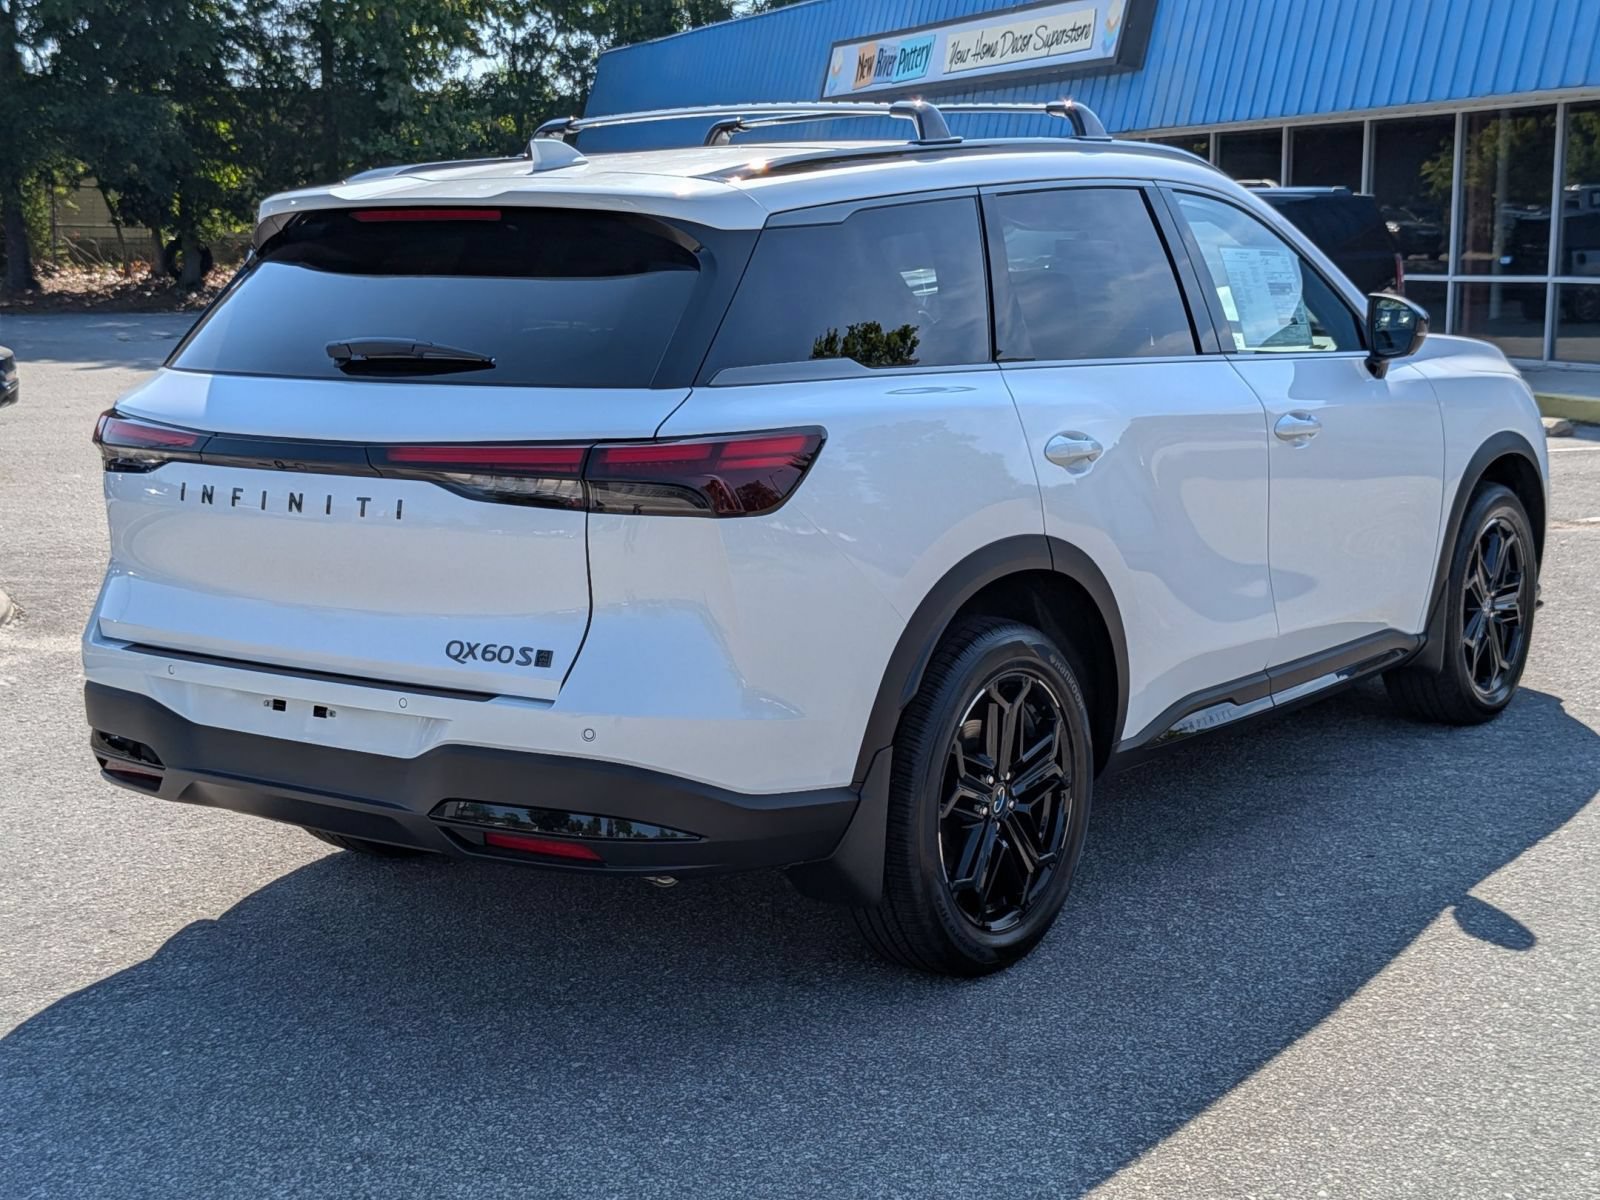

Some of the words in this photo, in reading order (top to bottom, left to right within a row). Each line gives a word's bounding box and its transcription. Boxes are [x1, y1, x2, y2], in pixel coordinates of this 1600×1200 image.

[855, 52, 875, 82] New
[874, 47, 898, 77] River
[896, 42, 932, 76] Pottery
[949, 40, 971, 72] Your
[971, 31, 999, 62] Home
[1000, 30, 1034, 58] Decor
[1033, 22, 1092, 56] Superstore
[180, 482, 403, 520] INFINITI
